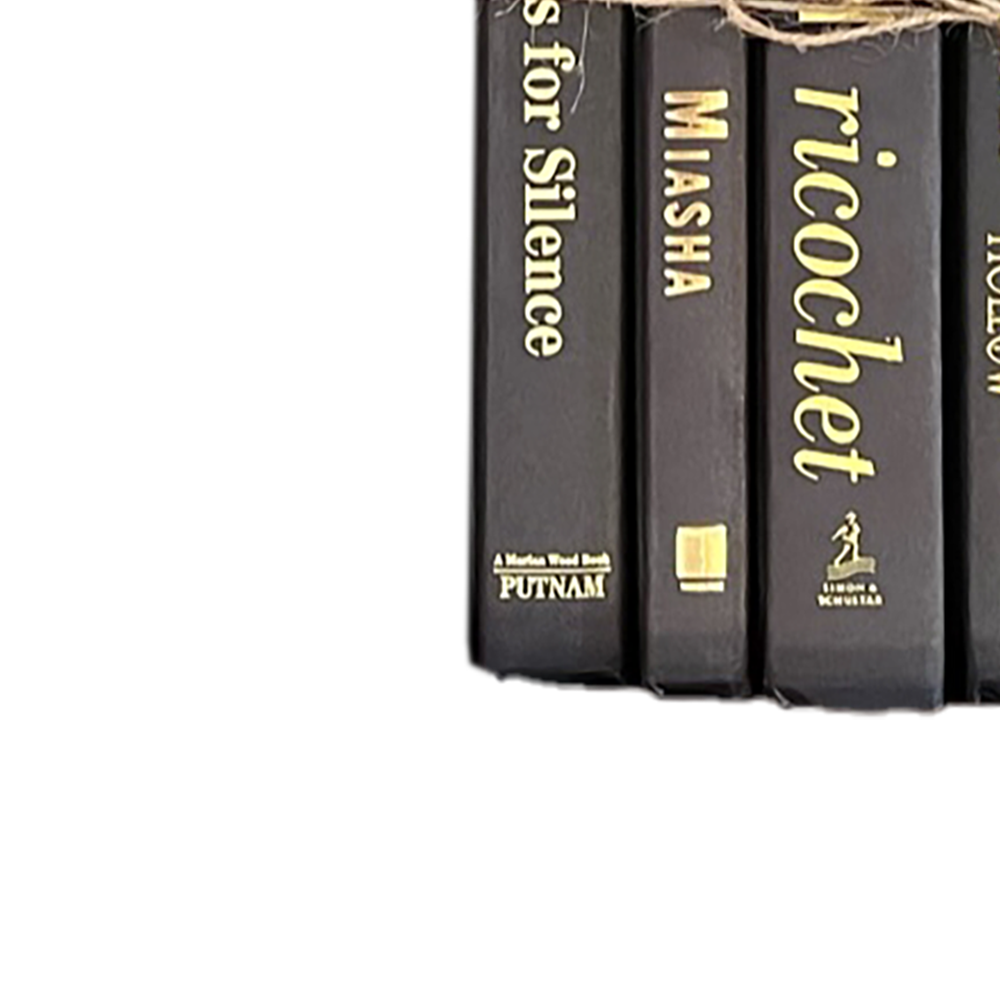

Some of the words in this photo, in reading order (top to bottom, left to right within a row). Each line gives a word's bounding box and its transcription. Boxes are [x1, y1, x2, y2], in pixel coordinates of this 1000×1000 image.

[522, 41, 577, 132] for
[523, 147, 576, 357] Silence
[663, 89, 729, 297] MIASHA
[793, 87, 904, 484] ricochet
[499, 573, 605, 600] PUTNAM
